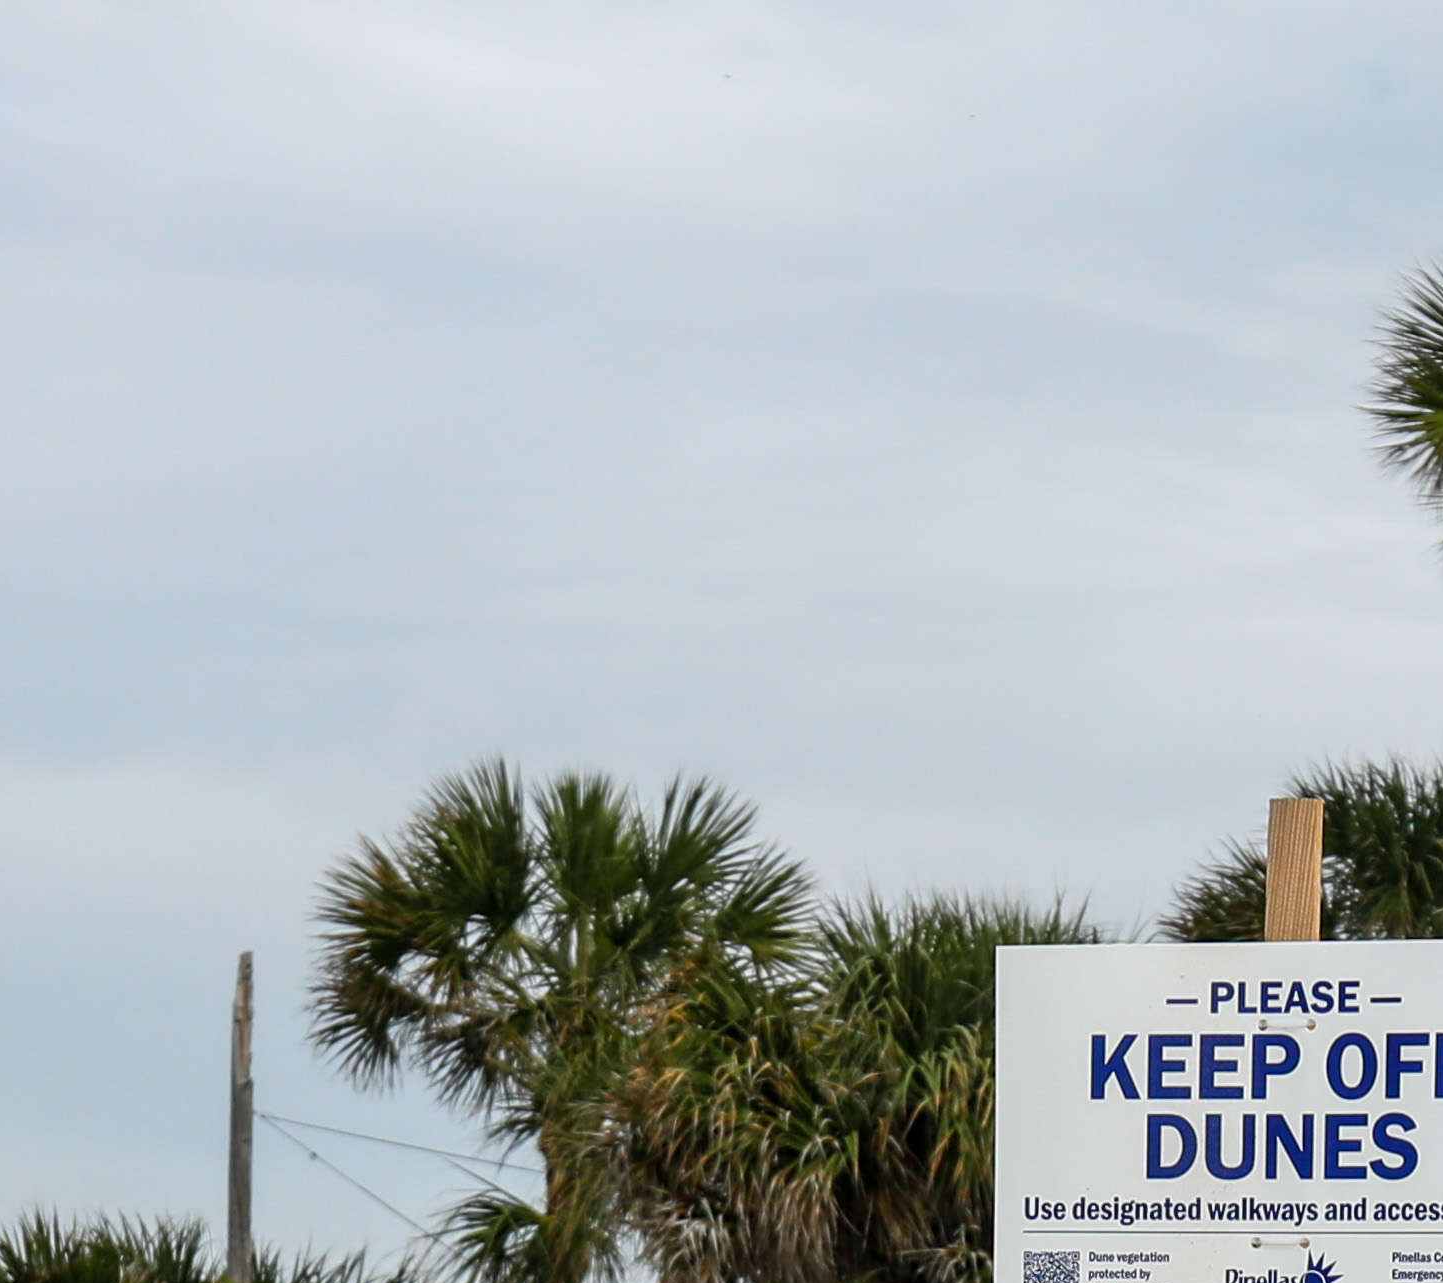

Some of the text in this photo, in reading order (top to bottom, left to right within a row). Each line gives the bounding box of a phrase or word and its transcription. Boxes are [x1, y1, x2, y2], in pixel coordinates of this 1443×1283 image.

[1211, 981, 1360, 1013] PLEASE
[1091, 1033, 1300, 1099] KEEP
[1146, 1113, 1418, 1180] DUNES
[1025, 1197, 1066, 1220] Use
[1073, 1197, 1201, 1225] designated
[1208, 1198, 1318, 1226] walkways
[1325, 1198, 1366, 1221] and
[1089, 1252, 1169, 1264] Dune vegetation
[1392, 1252, 1430, 1262] Pinellas
[1089, 1269, 1150, 1281] protected by
